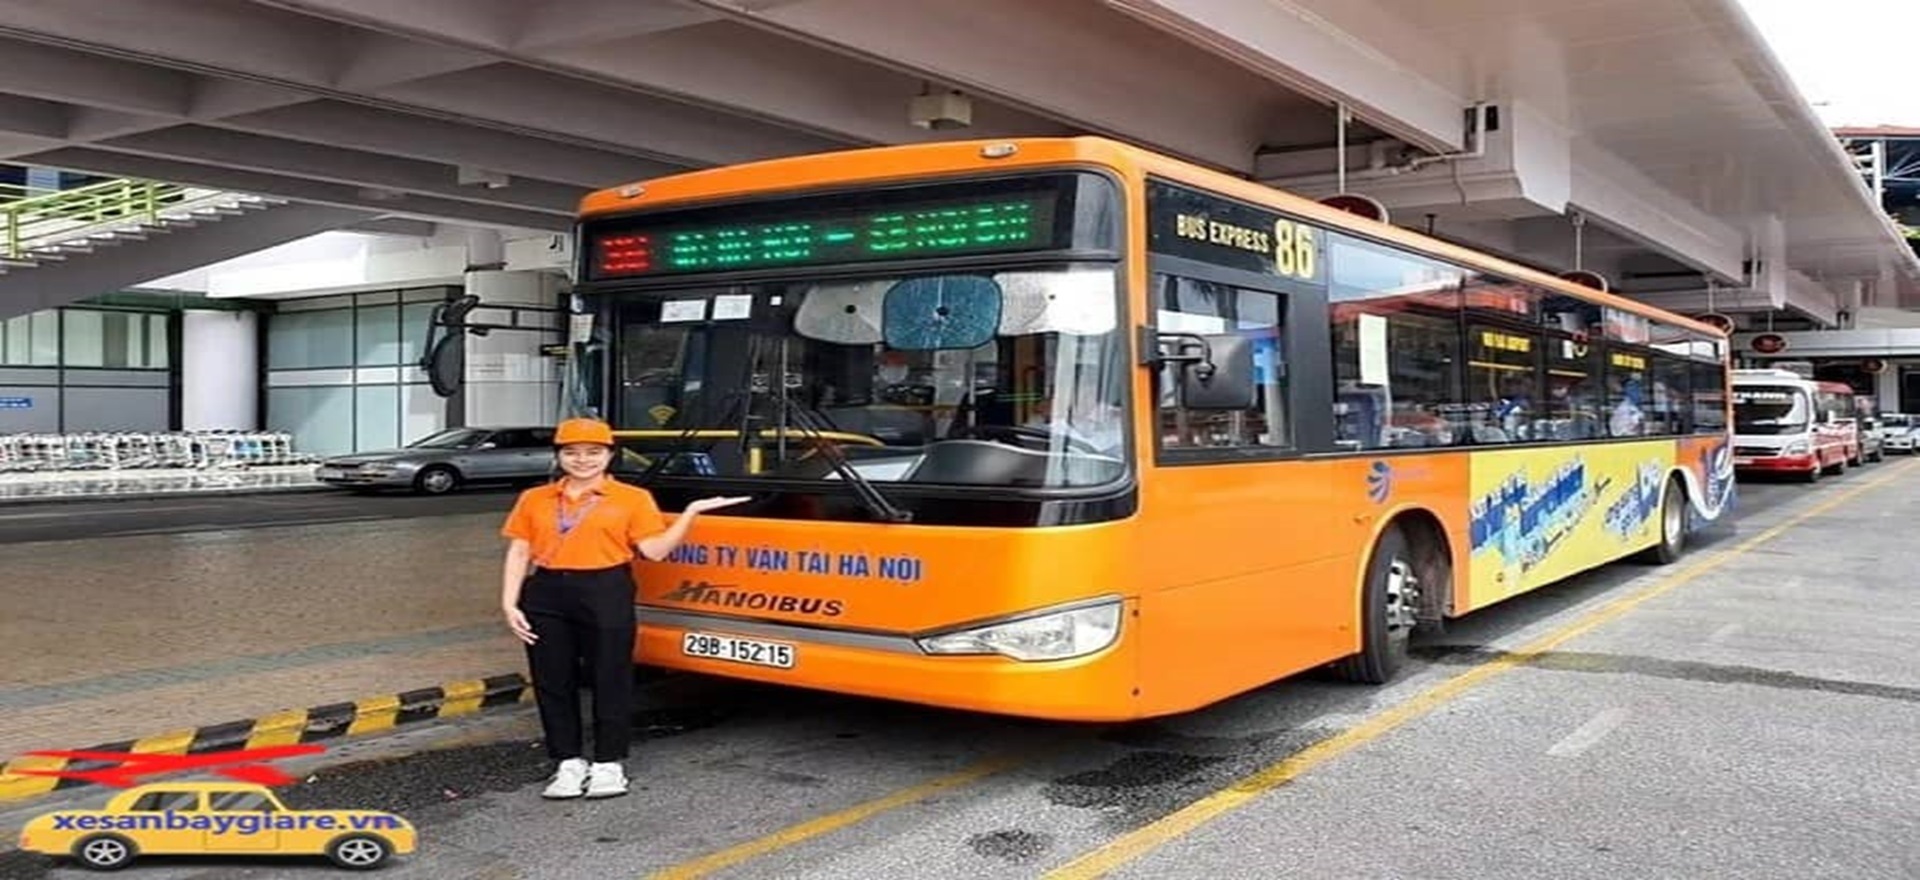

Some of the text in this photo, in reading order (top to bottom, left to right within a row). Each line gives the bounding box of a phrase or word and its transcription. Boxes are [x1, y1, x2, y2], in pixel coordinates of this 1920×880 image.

[1177, 214, 1269, 253] BUS EXPRESS
[1275, 218, 1314, 279] 86
[716, 546, 738, 568] TY
[663, 580, 844, 617] HANOIBUS
